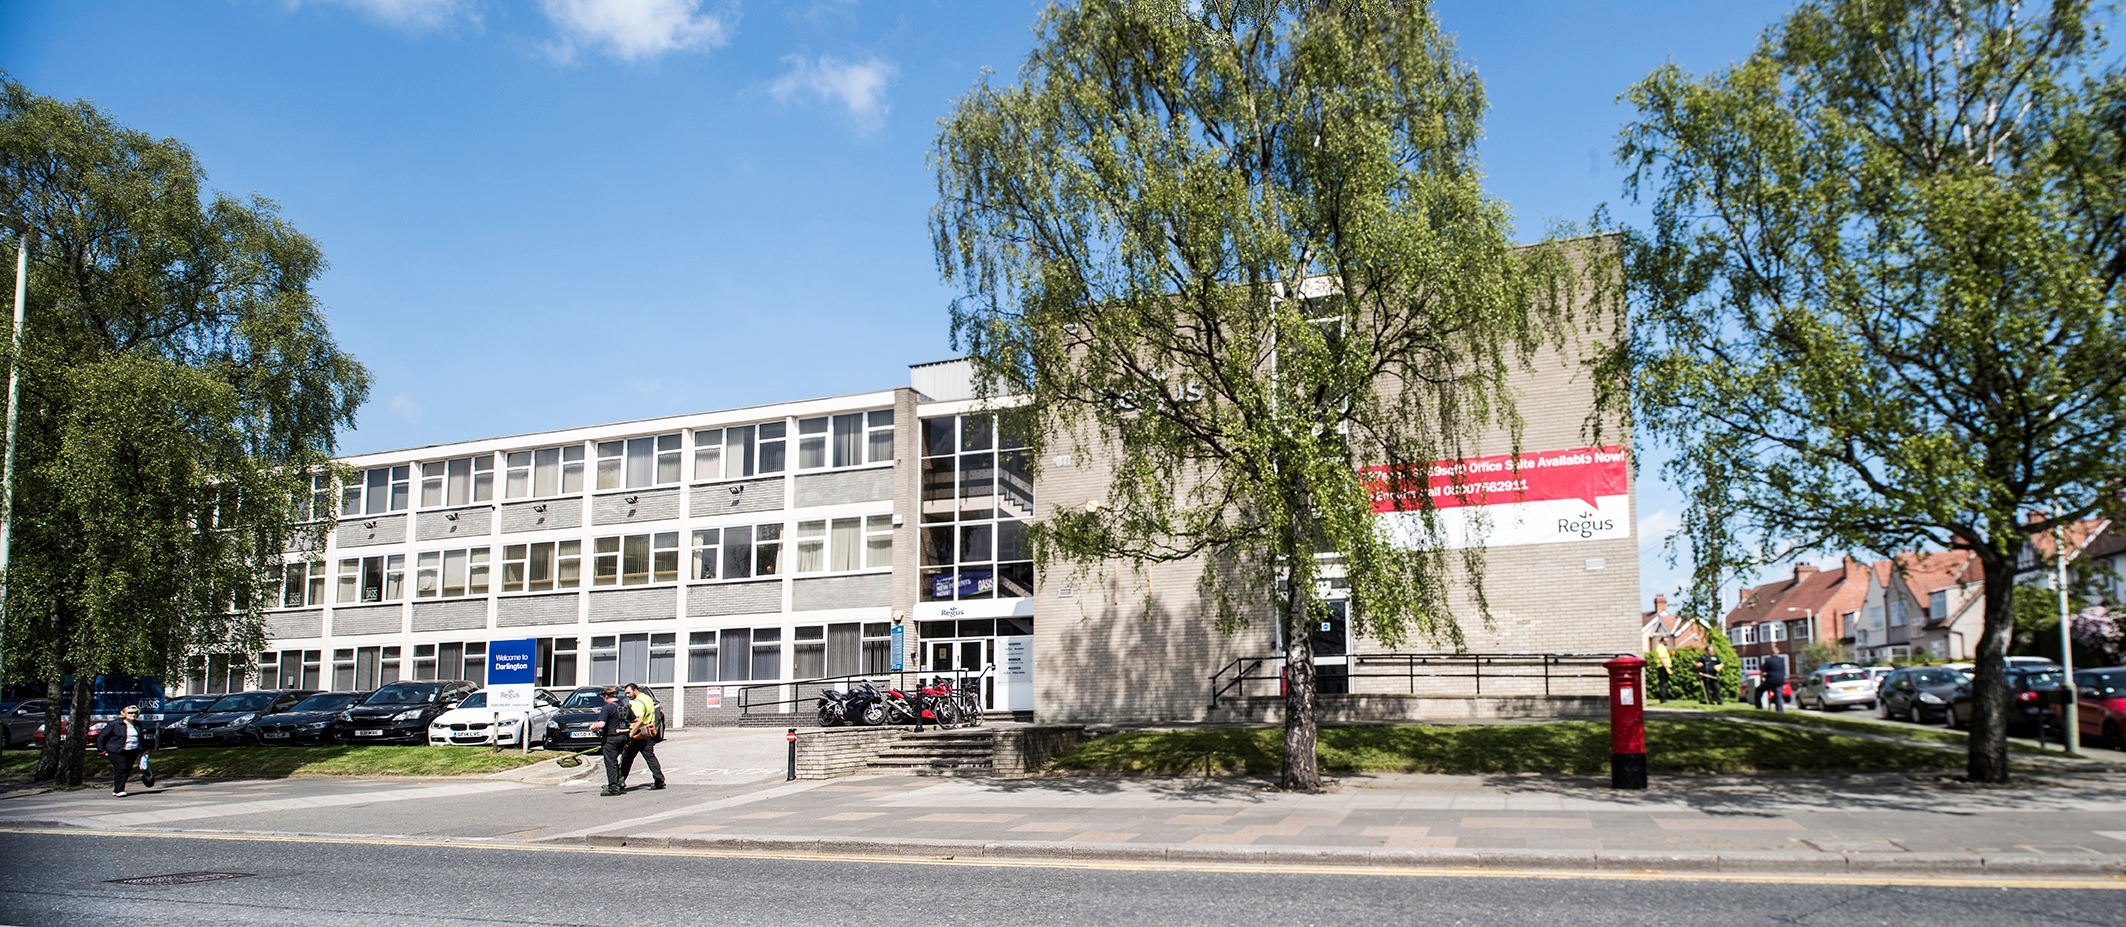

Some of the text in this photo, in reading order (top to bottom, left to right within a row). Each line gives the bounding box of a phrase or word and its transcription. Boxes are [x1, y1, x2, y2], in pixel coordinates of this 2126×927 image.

[1098, 382, 1203, 412] Reus
[1469, 461, 1502, 474] Office
[1505, 459, 1535, 471] Site
[1537, 453, 1592, 469] Available
[1594, 450, 1625, 463] Now!
[1558, 518, 1614, 538] Regus
[941, 609, 964, 617] Regus
[495, 662, 528, 671] Darlington
[500, 691, 520, 700] Regus
[138, 699, 160, 710] OASIS
